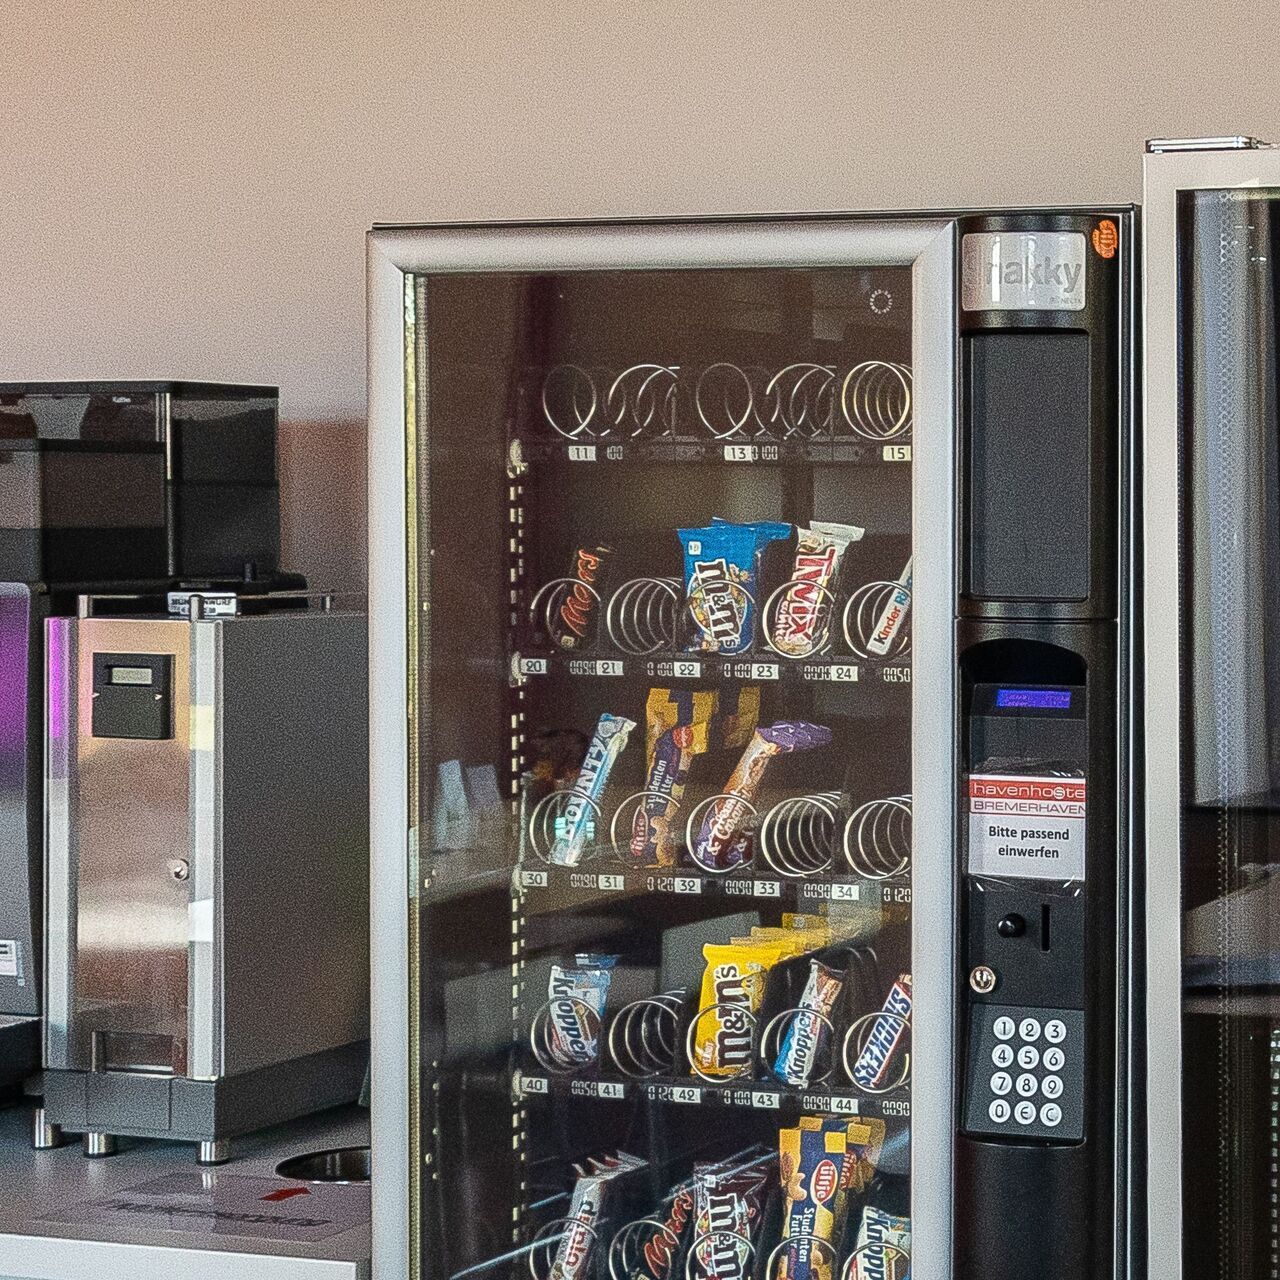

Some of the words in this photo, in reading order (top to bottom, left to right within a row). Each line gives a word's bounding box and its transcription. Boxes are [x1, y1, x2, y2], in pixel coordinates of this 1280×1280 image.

[575, 447, 589, 459] 11
[731, 447, 747, 459] 13
[890, 447, 906, 459] 15
[525, 661, 542, 672] 20
[679, 663, 696, 675] 22
[757, 664, 773, 677] 23
[836, 667, 852, 680] 24
[974, 801, 1085, 814] BREMERHAVEN
[989, 825, 1017, 838] Bitte
[1021, 828, 1069, 843] passend
[998, 846, 1059, 858] einwerfen
[526, 874, 543, 885] 30
[603, 876, 618, 889] 31
[680, 879, 696, 892] 32
[759, 882, 776, 895] 33
[836, 886, 853, 899] 34
[715, 964, 753, 1069] m&m's
[1001, 1021, 1007, 1036] 1
[1025, 1023, 1034, 1037] 2
[1050, 1024, 1060, 1038] 3
[788, 1000, 813, 1080] Knoppers
[997, 1049, 1007, 1063] 4
[1023, 1051, 1032, 1065] 5
[1049, 1052, 1058, 1066] 6
[526, 1080, 543, 1091] 40
[997, 1076, 1006, 1090] 7
[1022, 1078, 1031, 1092] 8
[1048, 1080, 1057, 1094] 9
[679, 1089, 695, 1102] 42
[758, 1094, 774, 1107] 43
[836, 1099, 853, 1112] 44
[995, 1104, 1004, 1118] 0
[1045, 1108, 1055, 1122] C
[816, 1164, 834, 1199] ültje
[798, 1206, 816, 1263] Studnten
